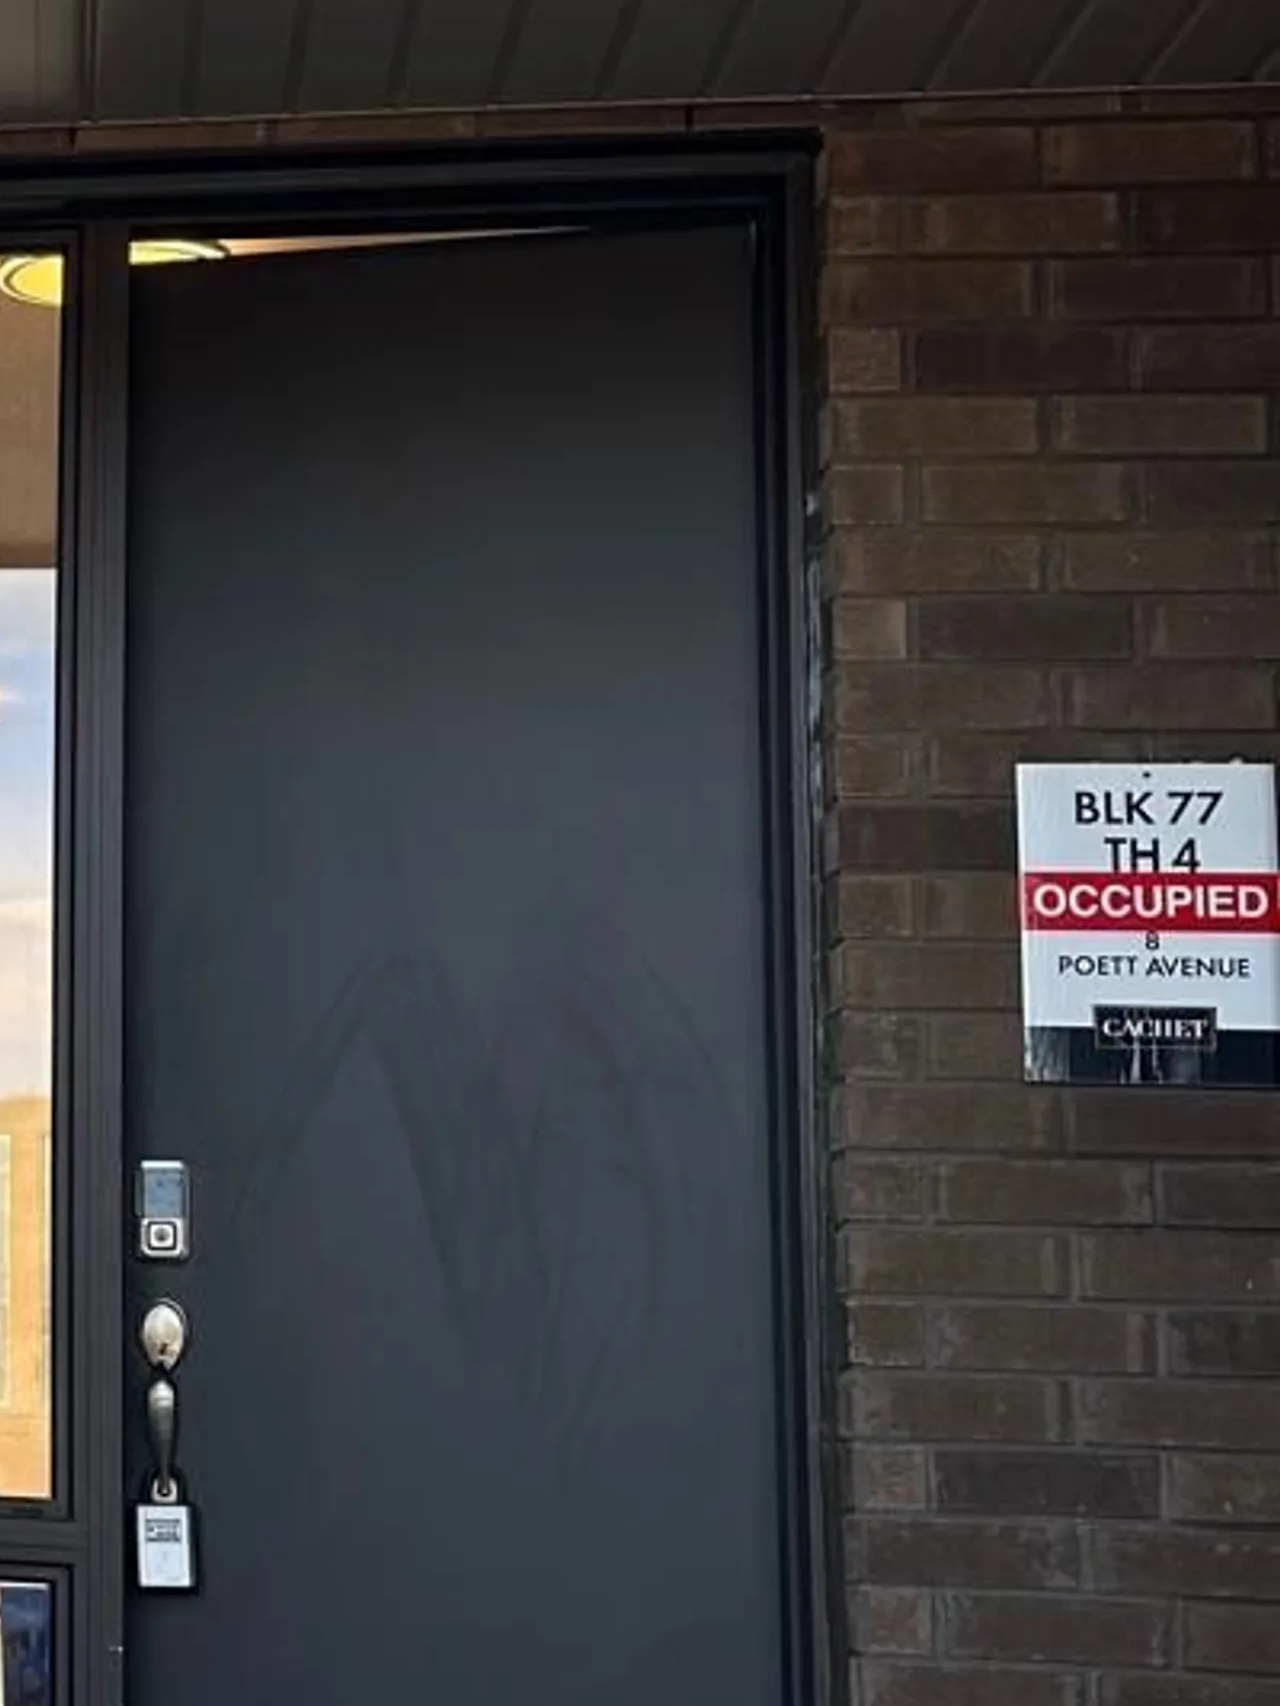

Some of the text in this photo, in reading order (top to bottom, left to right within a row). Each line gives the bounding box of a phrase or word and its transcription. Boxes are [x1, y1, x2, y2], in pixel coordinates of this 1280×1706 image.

[1074, 792, 1225, 825] BLK 77
[1104, 837, 1201, 873] TH 4
[1034, 884, 1270, 919] OCCUPIED
[1145, 930, 1160, 950] 8
[1058, 955, 1252, 979] POETT AVENUE
[1102, 1015, 1209, 1039] CACHET
